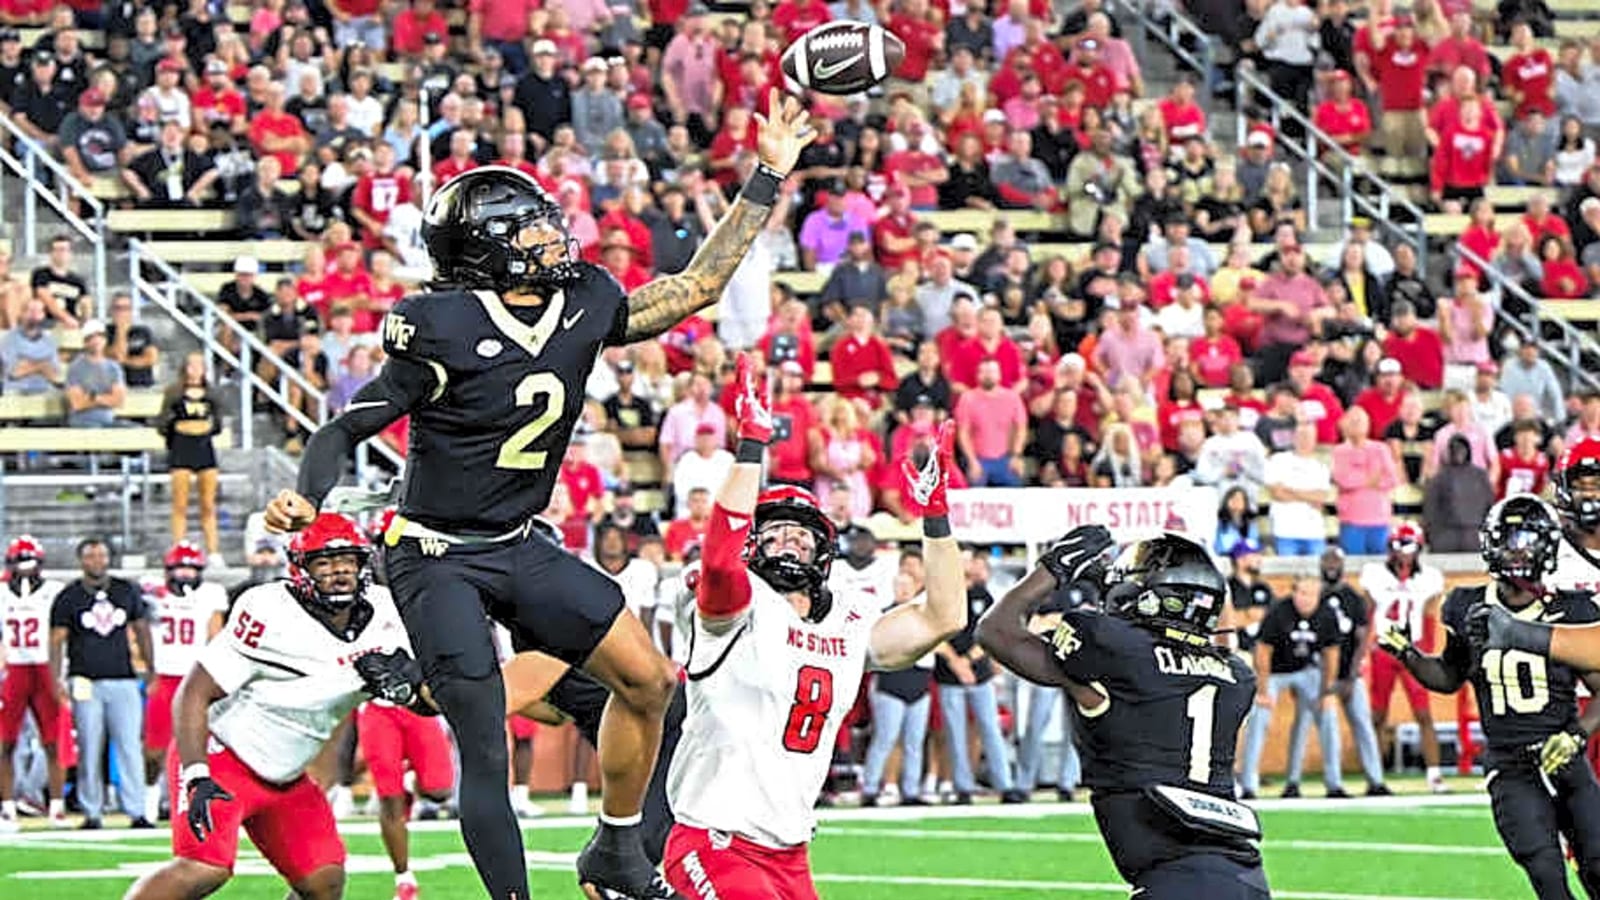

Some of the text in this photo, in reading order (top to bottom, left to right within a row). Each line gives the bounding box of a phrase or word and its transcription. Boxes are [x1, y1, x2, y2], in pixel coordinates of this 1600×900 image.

[385, 312, 417, 352] WF
[495, 372, 566, 470] 2
[6, 617, 40, 648] 32
[233, 610, 266, 649] 52
[786, 625, 847, 657] NC STATE
[1481, 649, 1550, 715] 10
[782, 664, 833, 754] 8
[1187, 682, 1219, 784] 1
